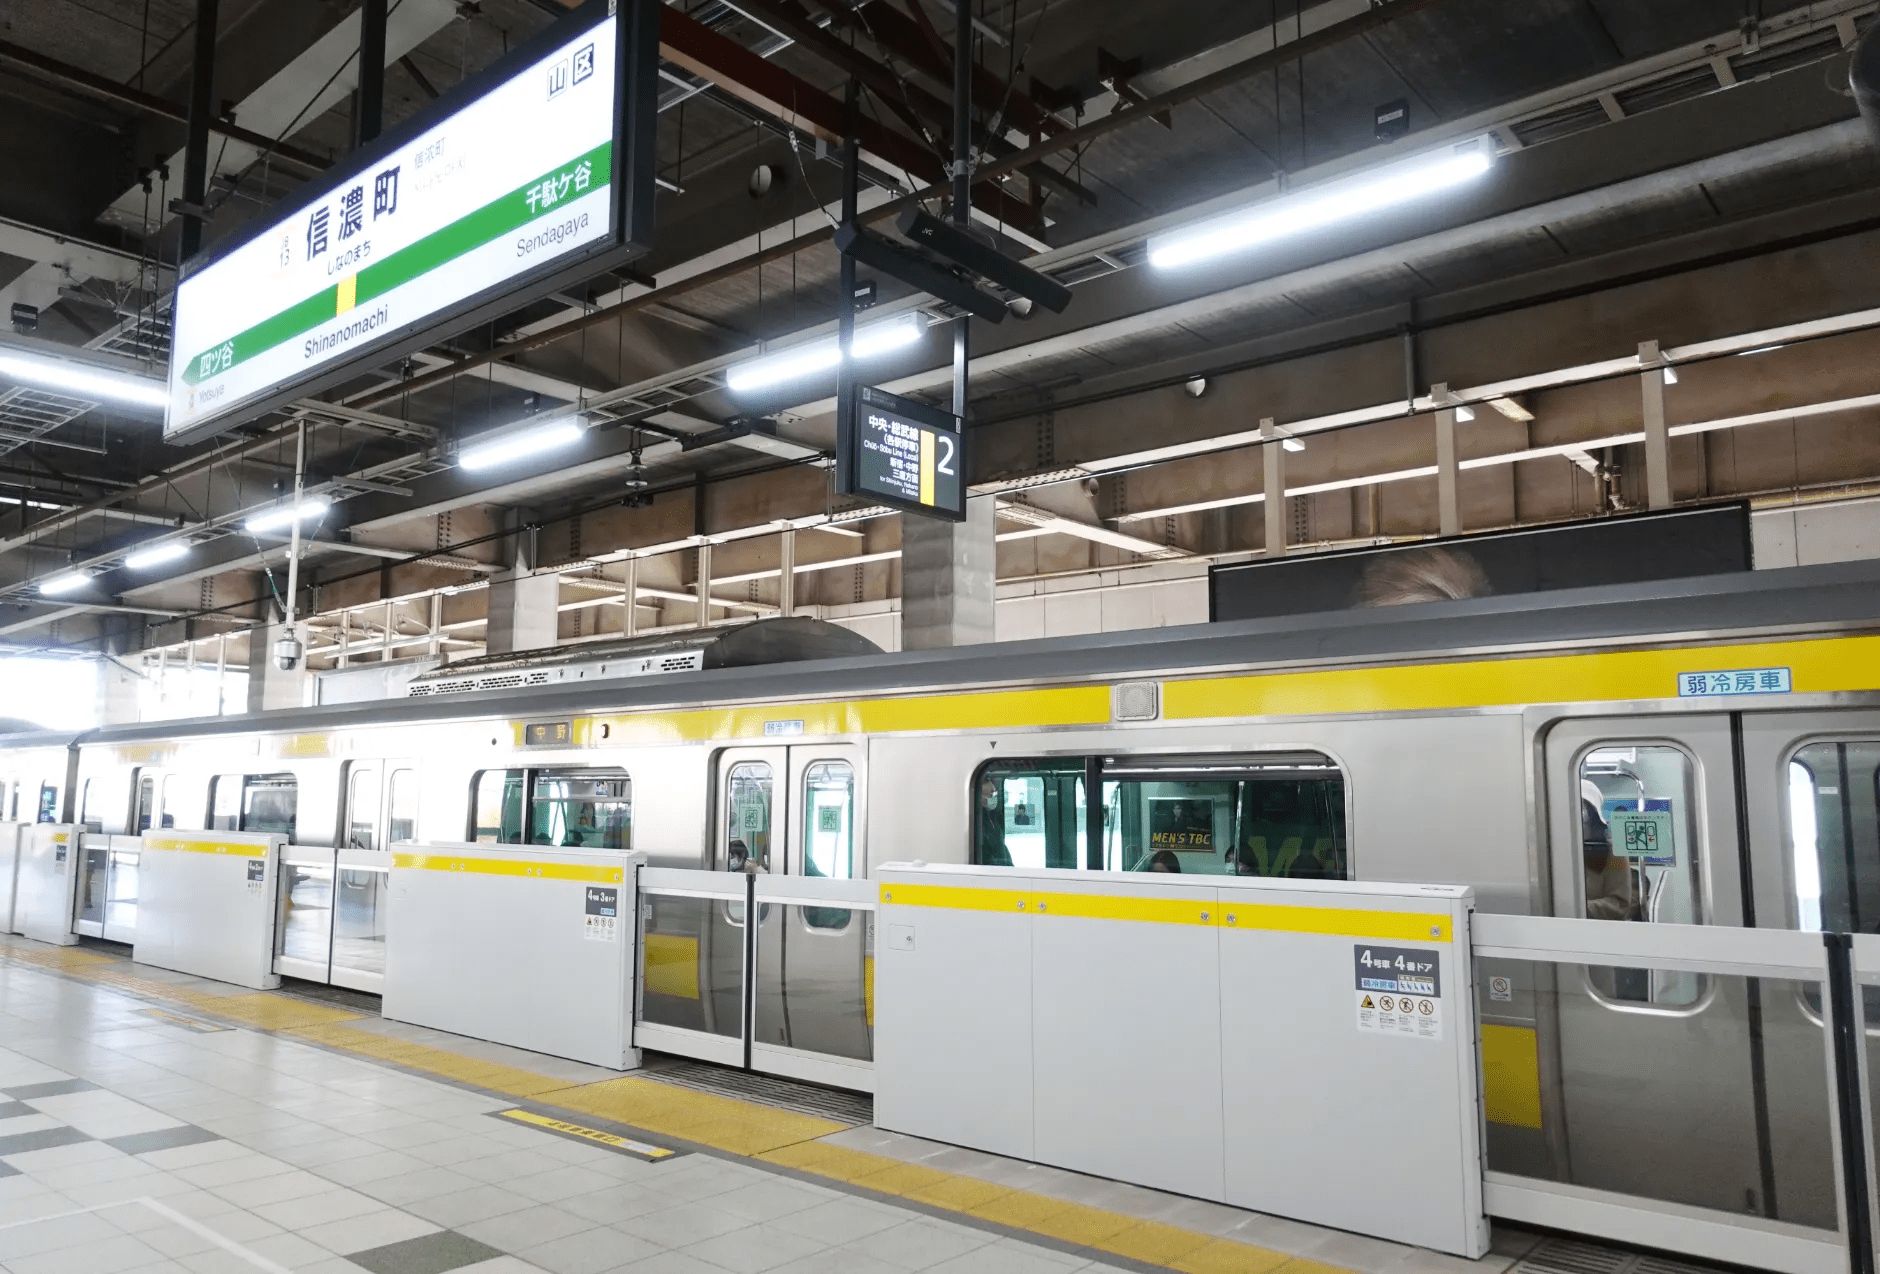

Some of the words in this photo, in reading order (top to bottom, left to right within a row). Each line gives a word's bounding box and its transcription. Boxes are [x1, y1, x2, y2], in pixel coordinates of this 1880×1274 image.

[306, 165, 401, 262] 信濃町
[516, 213, 589, 257] Sendagaya
[328, 240, 371, 275] しなのまち
[304, 303, 388, 359] Shinanomachi
[200, 340, 235, 379] 四ツ谷
[937, 435, 955, 476] 2
[1686, 670, 1783, 696] 弱冷房車
[1152, 832, 1186, 844] MEN'S
[1188, 833, 1212, 845] TBC
[1360, 949, 1391, 969] 4号車
[1394, 954, 1434, 973] 4番ドア
